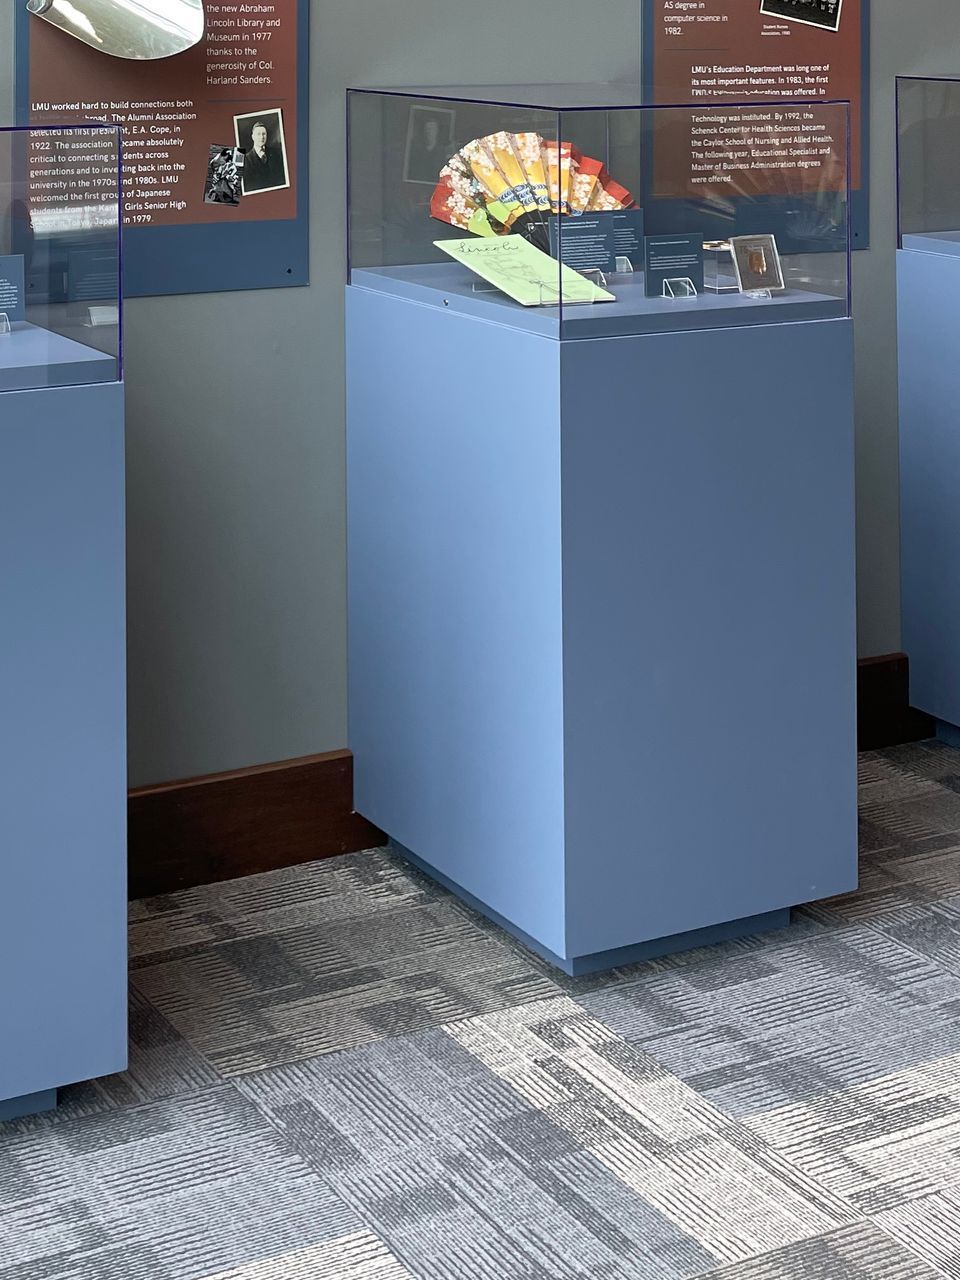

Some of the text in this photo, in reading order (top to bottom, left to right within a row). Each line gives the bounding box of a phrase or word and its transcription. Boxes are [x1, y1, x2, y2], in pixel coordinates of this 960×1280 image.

[746, 65, 782, 74] Department
[796, 65, 810, 73] long
[717, 78, 748, 86] important
[32, 103, 50, 111] LMU
[52, 102, 80, 110] worked
[691, 115, 728, 124] Technology
[775, 113, 783, 121] By
